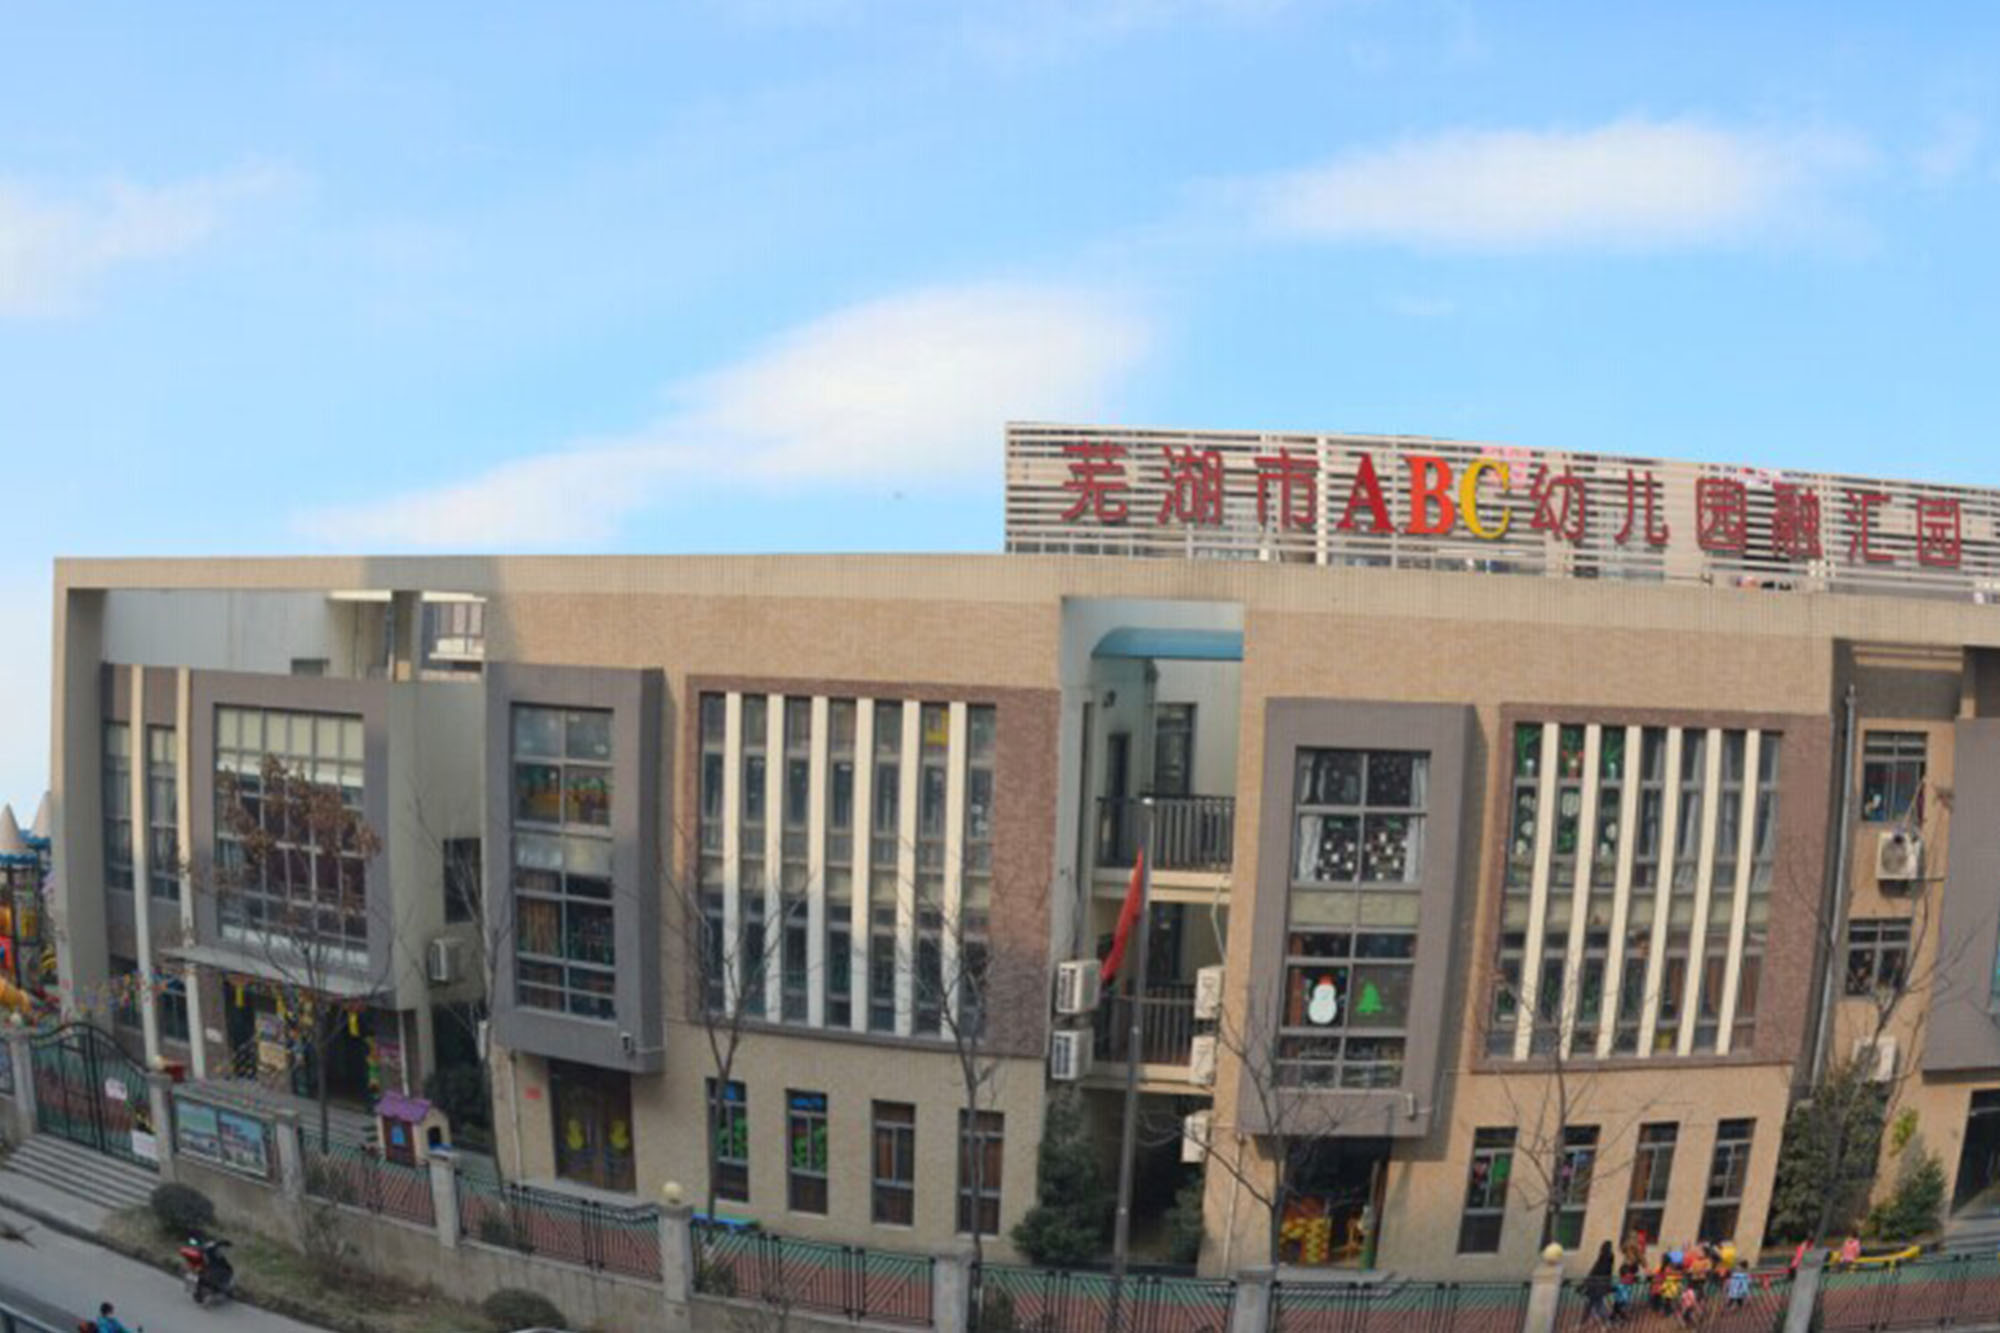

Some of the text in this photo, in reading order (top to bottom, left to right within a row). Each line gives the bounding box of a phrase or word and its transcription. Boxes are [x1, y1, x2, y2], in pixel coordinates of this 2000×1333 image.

[1061, 440, 1961, 567] 芜湖市ABC幼儿园融汇园
